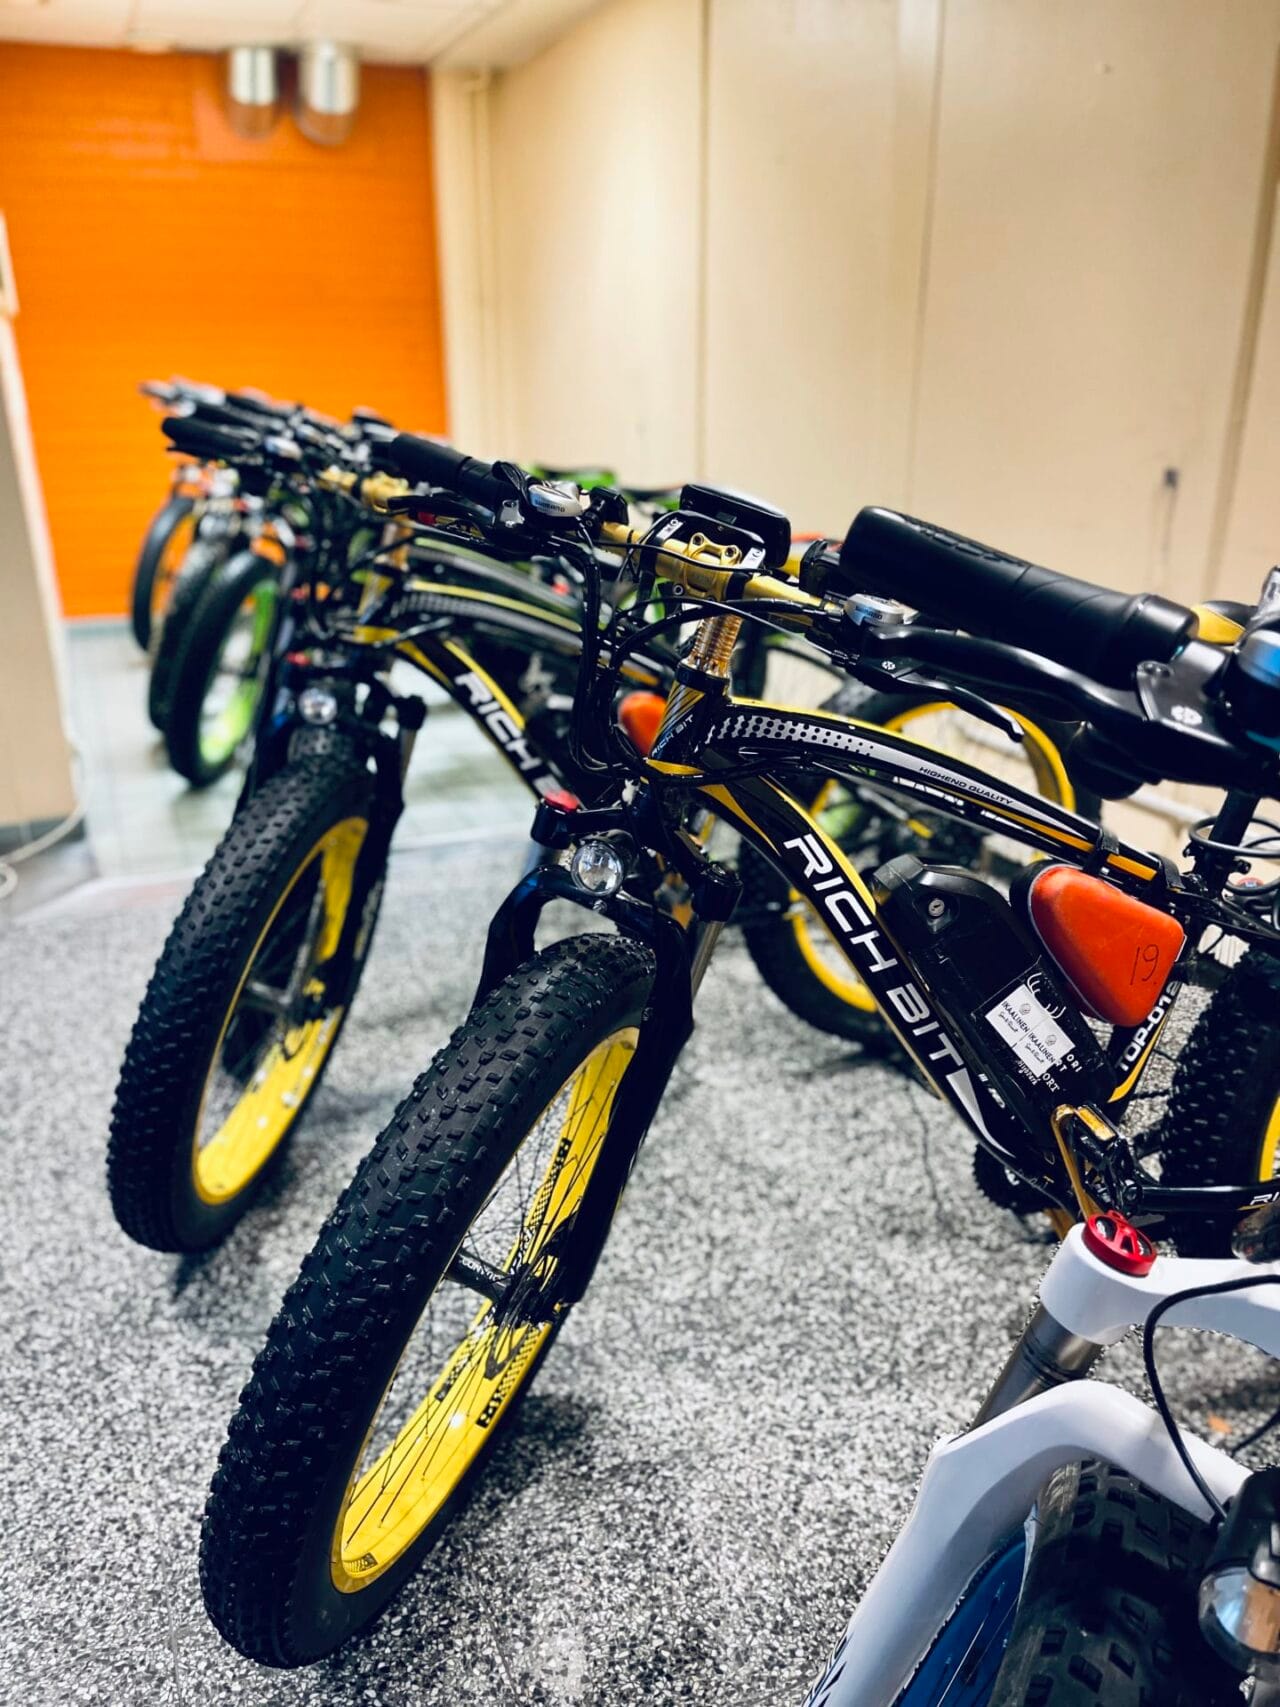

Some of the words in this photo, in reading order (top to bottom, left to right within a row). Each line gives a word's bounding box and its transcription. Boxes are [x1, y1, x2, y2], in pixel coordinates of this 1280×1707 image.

[455, 672, 542, 771] RICH
[919, 766, 967, 788] HIGHEND
[968, 785, 1014, 805] QUALITY
[783, 833, 898, 973] RICH
[886, 982, 965, 1067] BIT
[1001, 1001, 1030, 1033] IKAALINEN
[1028, 1032, 1056, 1063] IKAALINEN
